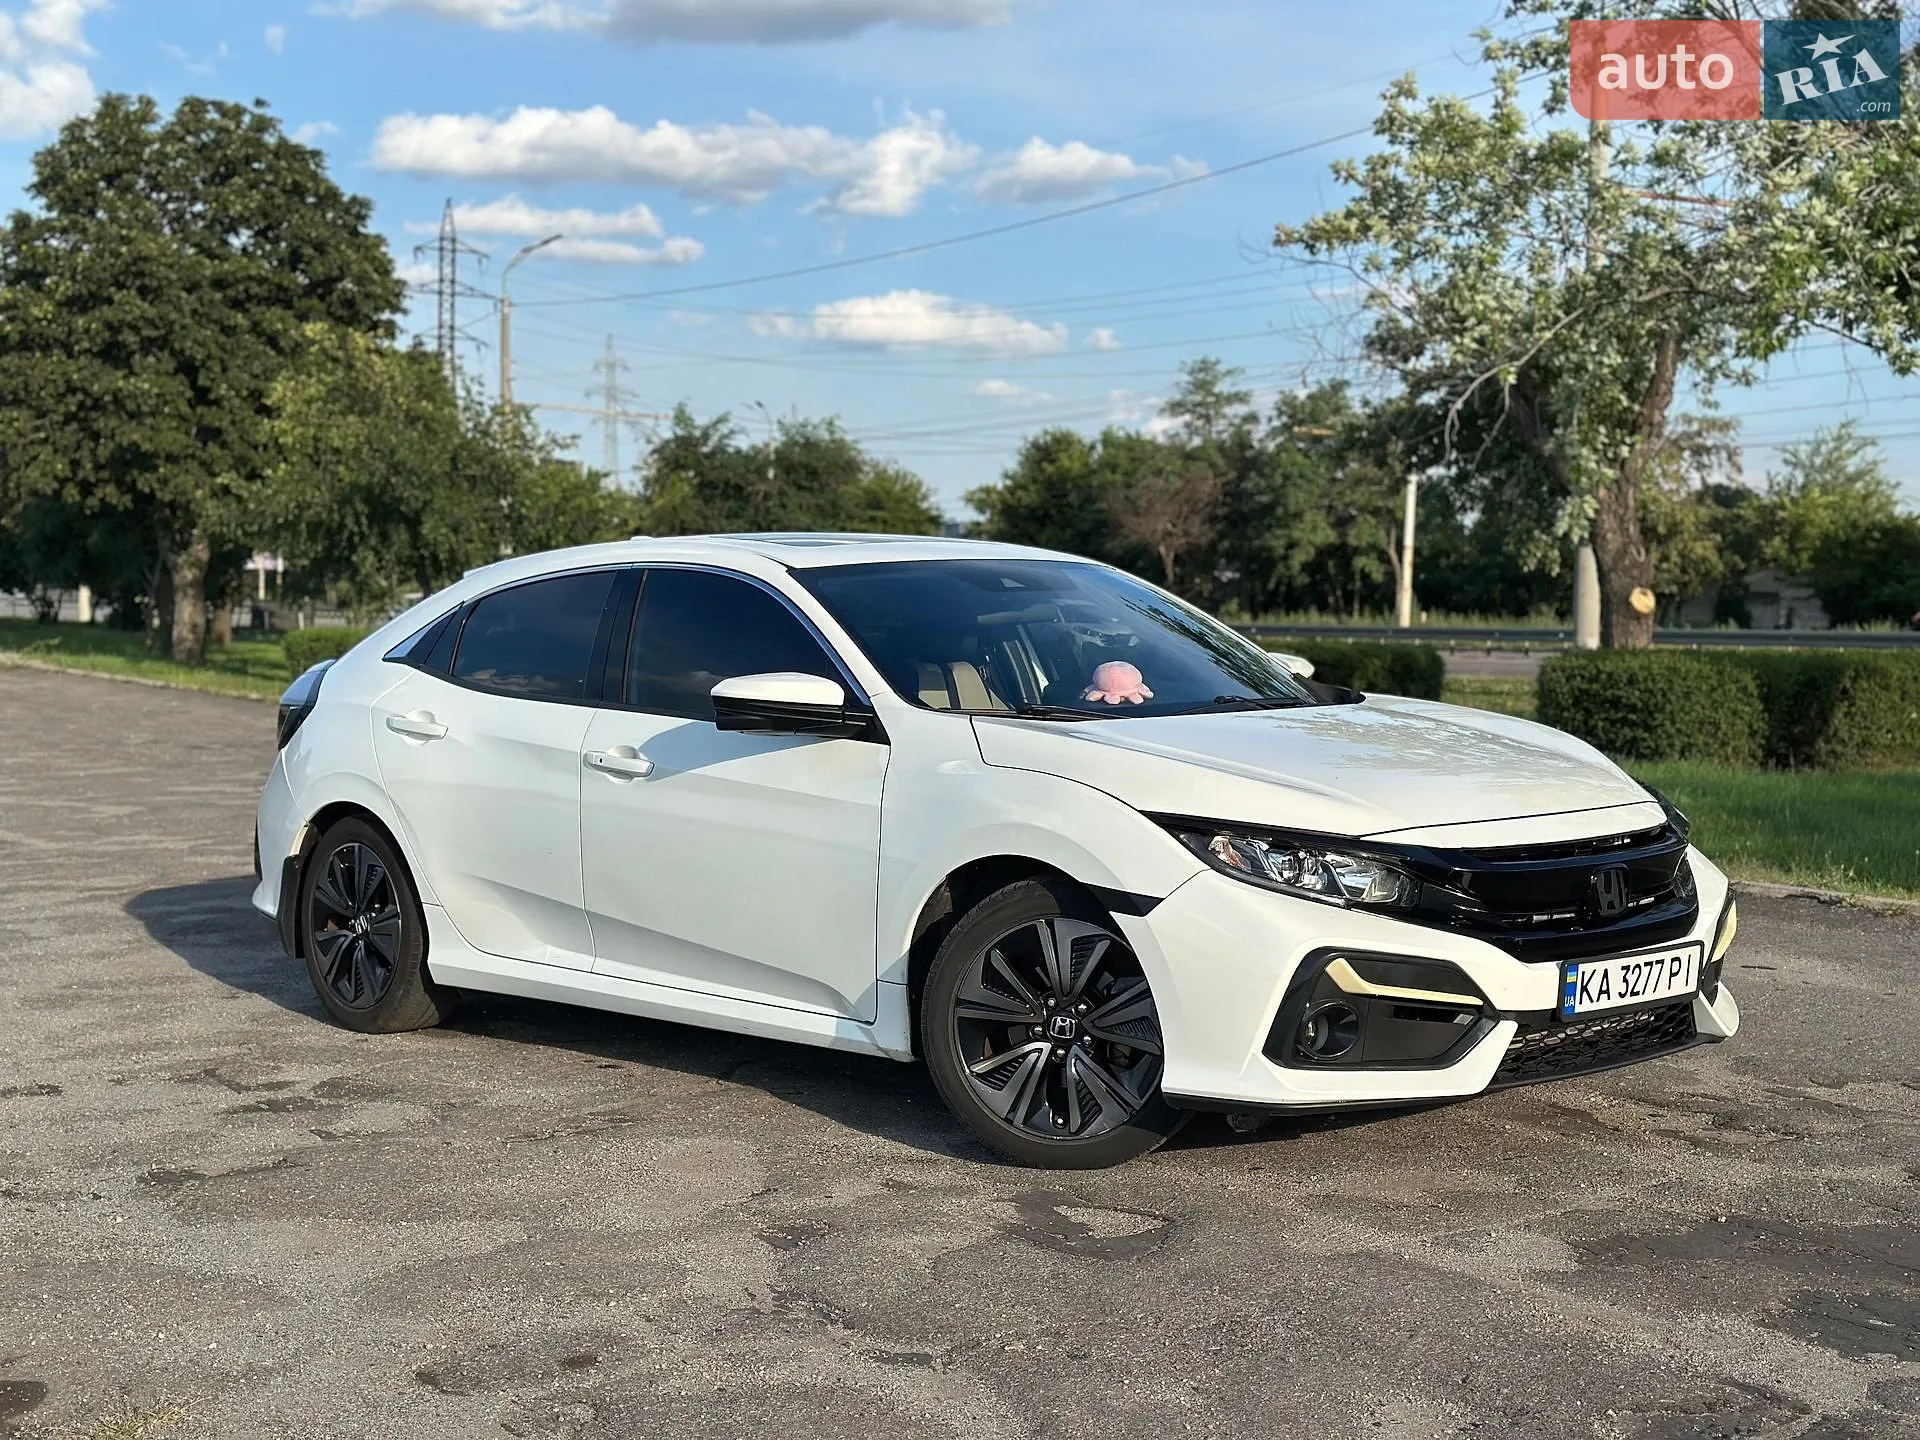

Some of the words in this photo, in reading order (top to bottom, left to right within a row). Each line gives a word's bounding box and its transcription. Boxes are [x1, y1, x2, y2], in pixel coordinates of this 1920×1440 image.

[1579, 968, 1611, 1005] KA
[1618, 959, 1665, 998] 3277
[1668, 954, 1692, 990] PI
[1564, 996, 1575, 1007] UA
